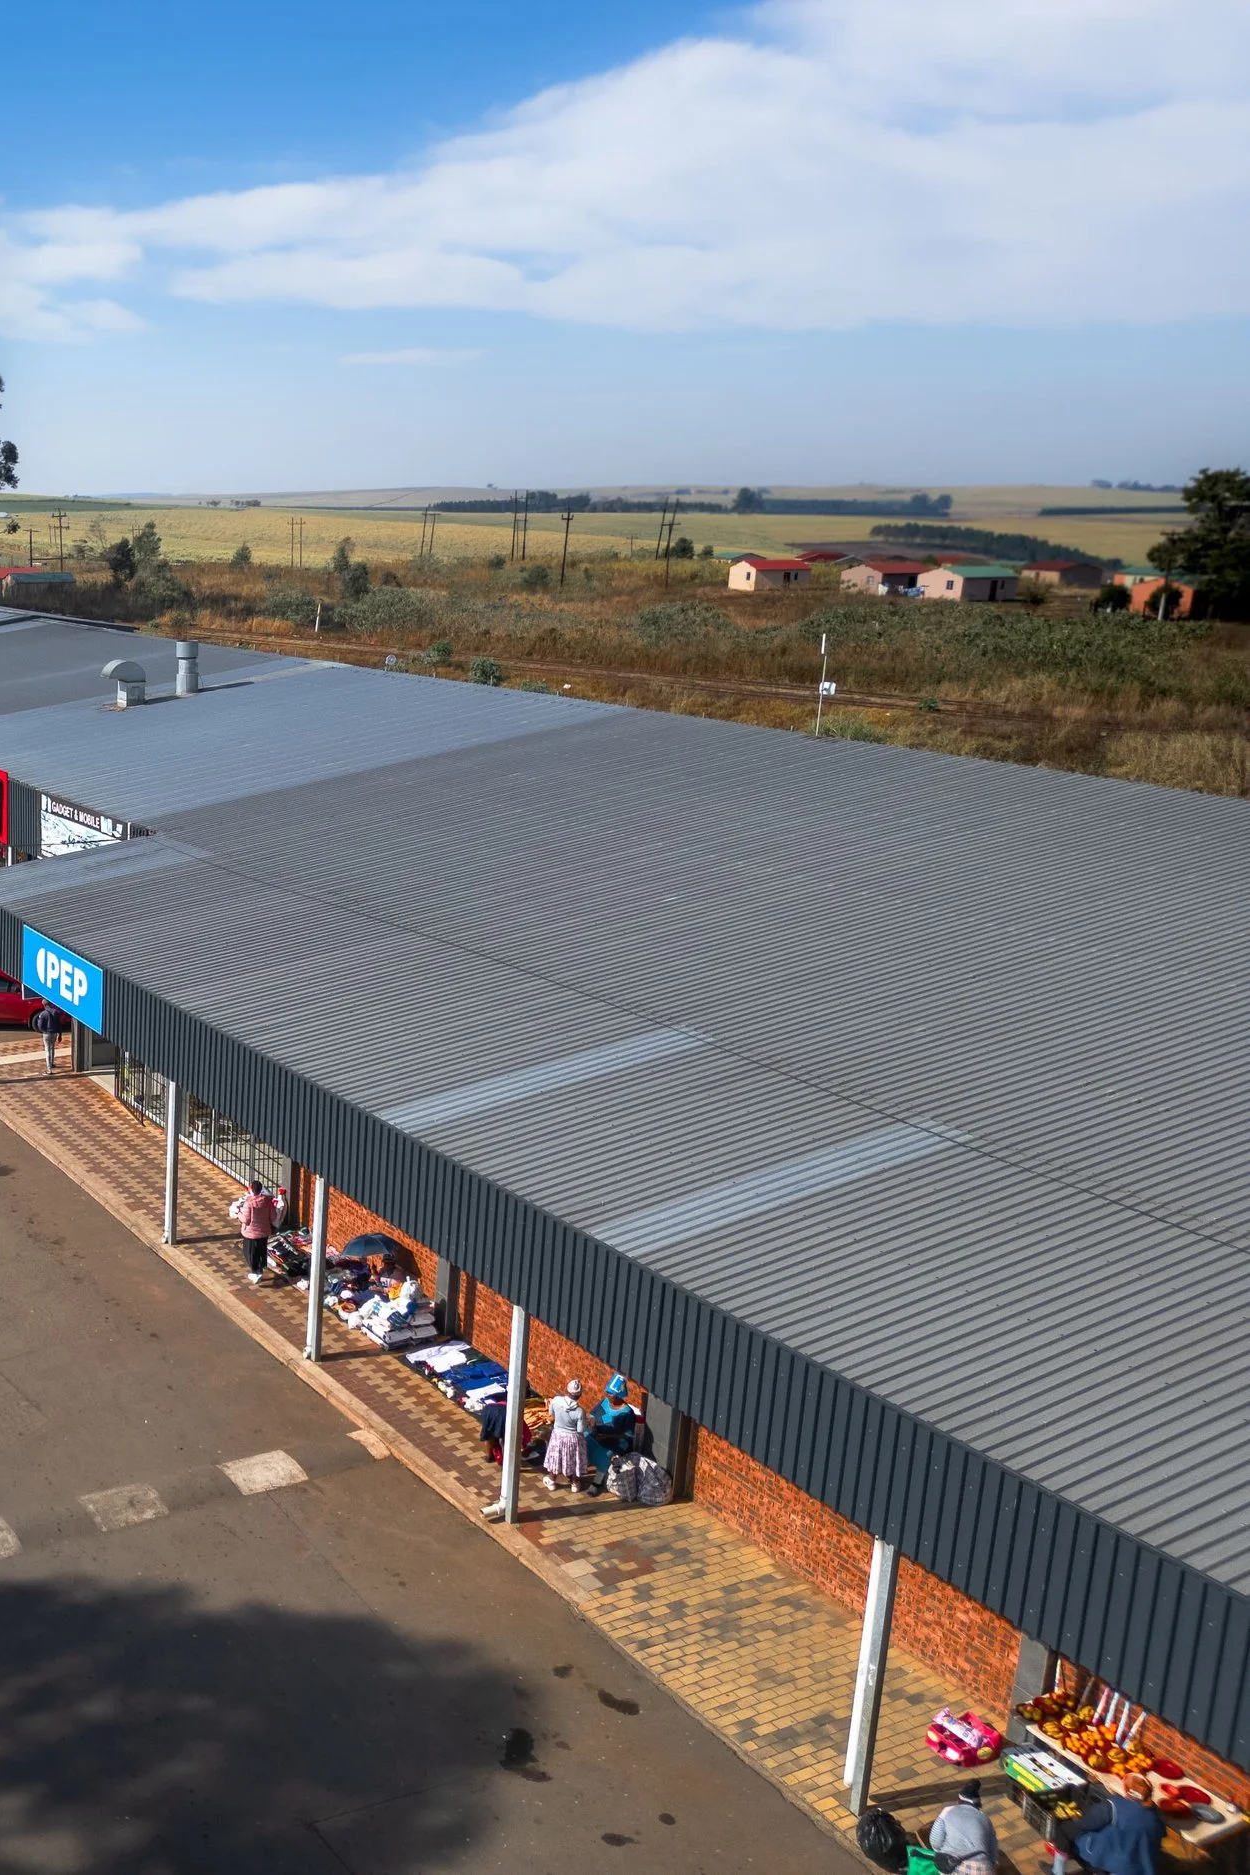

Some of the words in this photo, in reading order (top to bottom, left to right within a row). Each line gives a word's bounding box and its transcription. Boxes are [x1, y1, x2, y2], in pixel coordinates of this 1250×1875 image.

[51, 801, 73, 819] GADGET
[74, 809, 79, 820] &
[79, 811, 100, 828] MOBILE
[46, 950, 88, 1006] PEP
